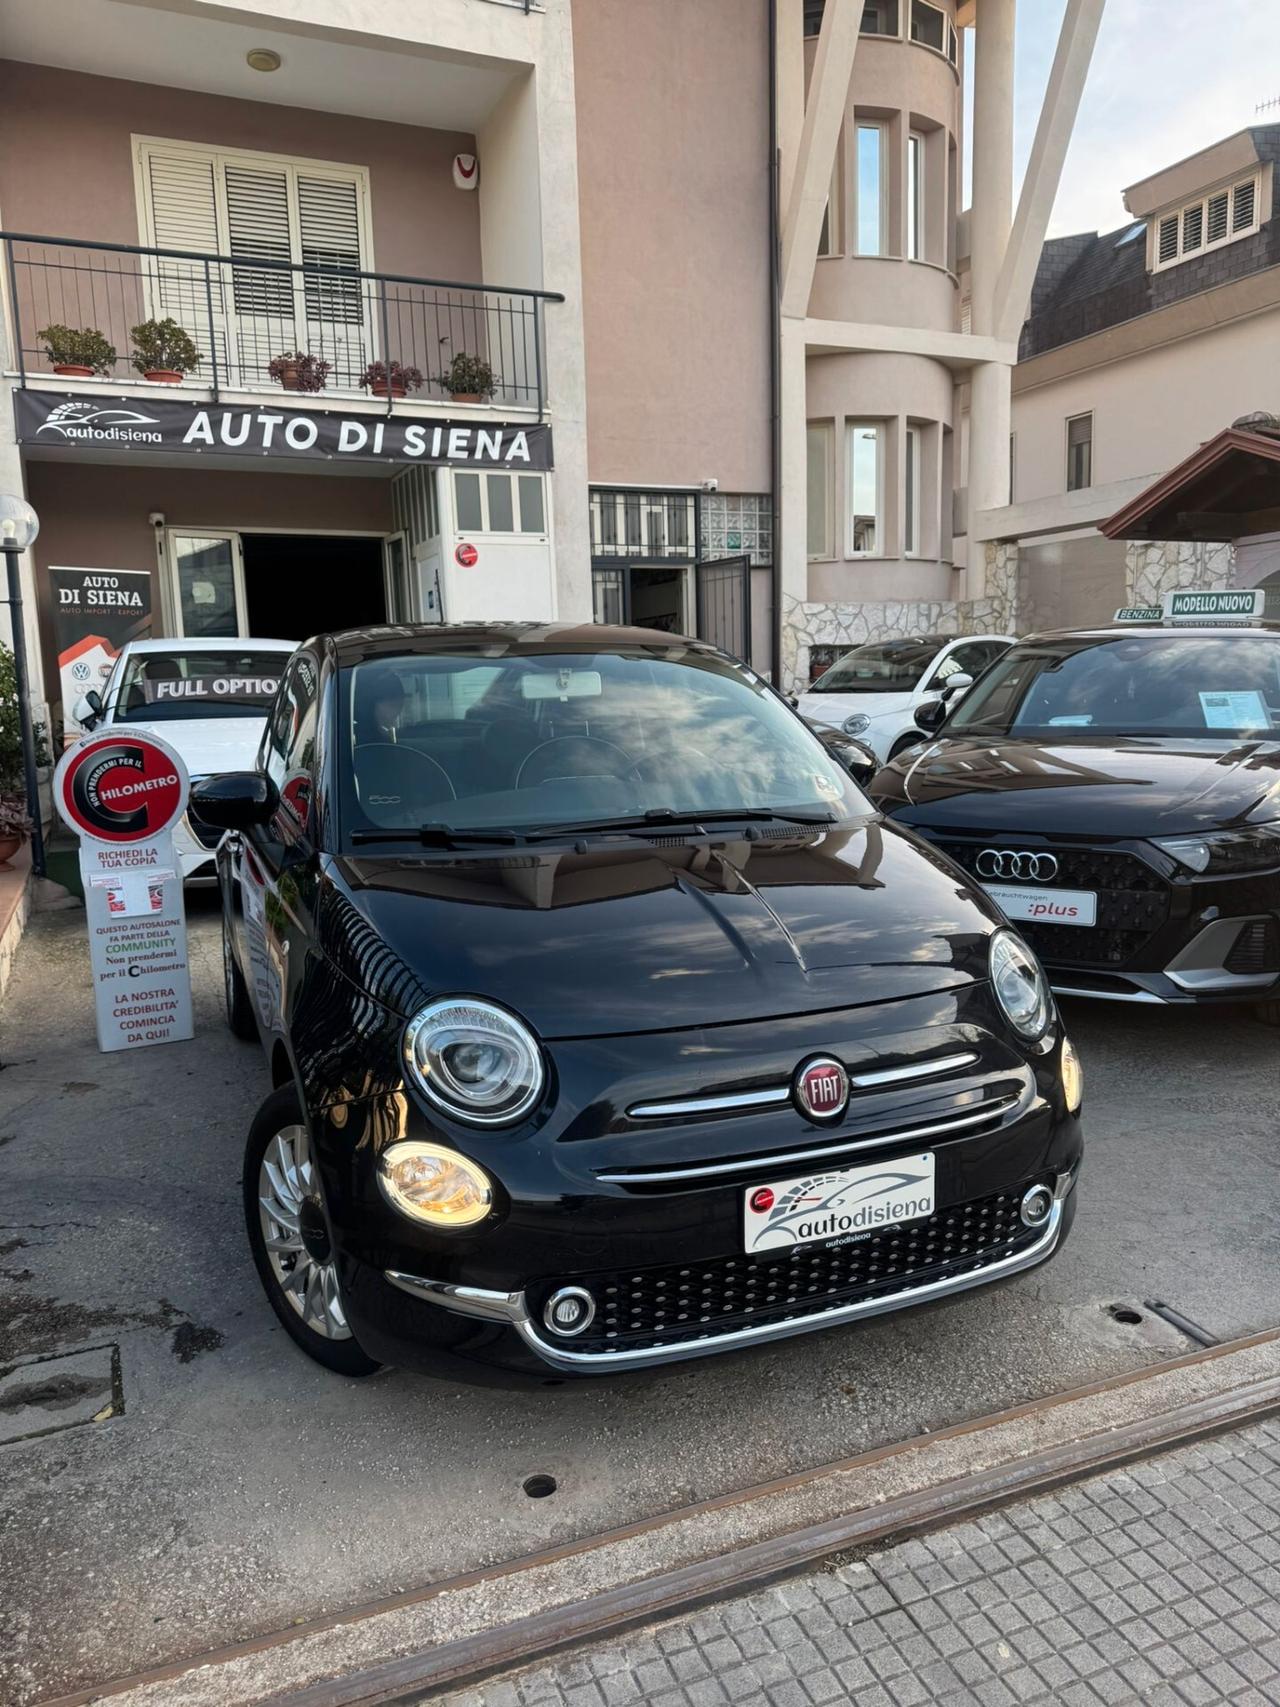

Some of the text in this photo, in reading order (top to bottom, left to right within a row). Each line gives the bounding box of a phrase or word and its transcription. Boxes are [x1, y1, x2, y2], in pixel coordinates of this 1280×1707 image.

[66, 426, 163, 443] autodisiena
[182, 411, 531, 462] AUTO DI SIENA
[83, 576, 119, 588] AUTO
[59, 589, 143, 607] DI SIENA
[1174, 596, 1253, 612] MODELLO NUOVO
[1120, 610, 1160, 619] BENZINA
[157, 680, 208, 699] FULL
[212, 678, 281, 695] OPTIO
[88, 758, 142, 808] NON PRENDERMI PER IL
[98, 848, 158, 861] RICHIEDI LA
[101, 857, 157, 868] TUA COPIA
[96, 919, 181, 935] QUESTO AUTOSALONE
[110, 930, 170, 943] FA PARTE DELLA
[105, 938, 176, 954] COMMUNITY
[106, 949, 177, 965] Non prendermi
[100, 962, 186, 981] per il Chilometro
[115, 988, 175, 1004] LA NOSTRA
[119, 1015, 176, 1030] COMINCIA
[127, 1029, 170, 1043] DA QUI!
[810, 1075, 839, 1105] FIAT
[798, 1196, 931, 1239] autodisiena
[825, 1231, 871, 1249] autodisiena
